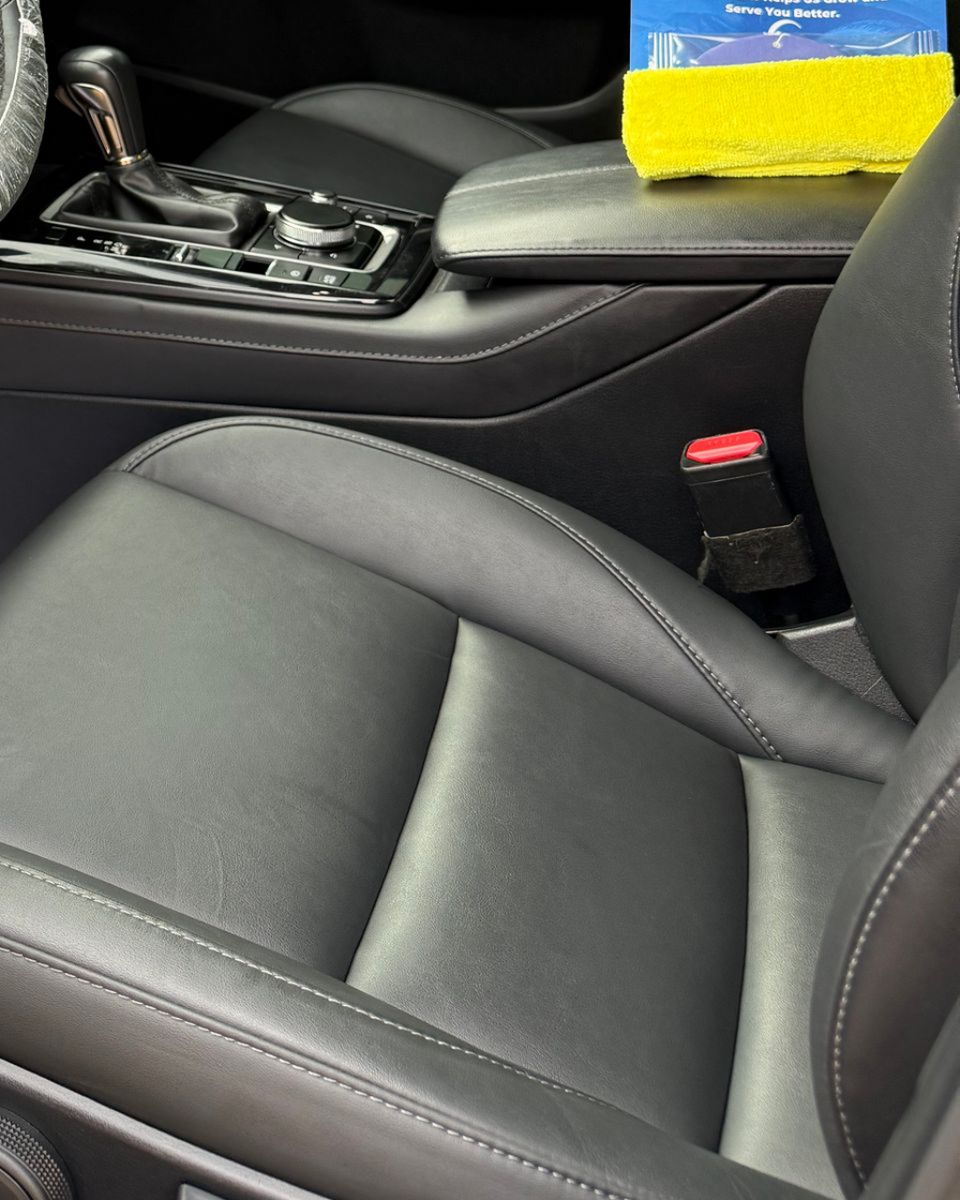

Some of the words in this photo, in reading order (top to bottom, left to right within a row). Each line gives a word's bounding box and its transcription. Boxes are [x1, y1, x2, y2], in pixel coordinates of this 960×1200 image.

[725, 4, 762, 16] Serve
[765, 6, 790, 17] You
[794, 7, 840, 19] Better.
